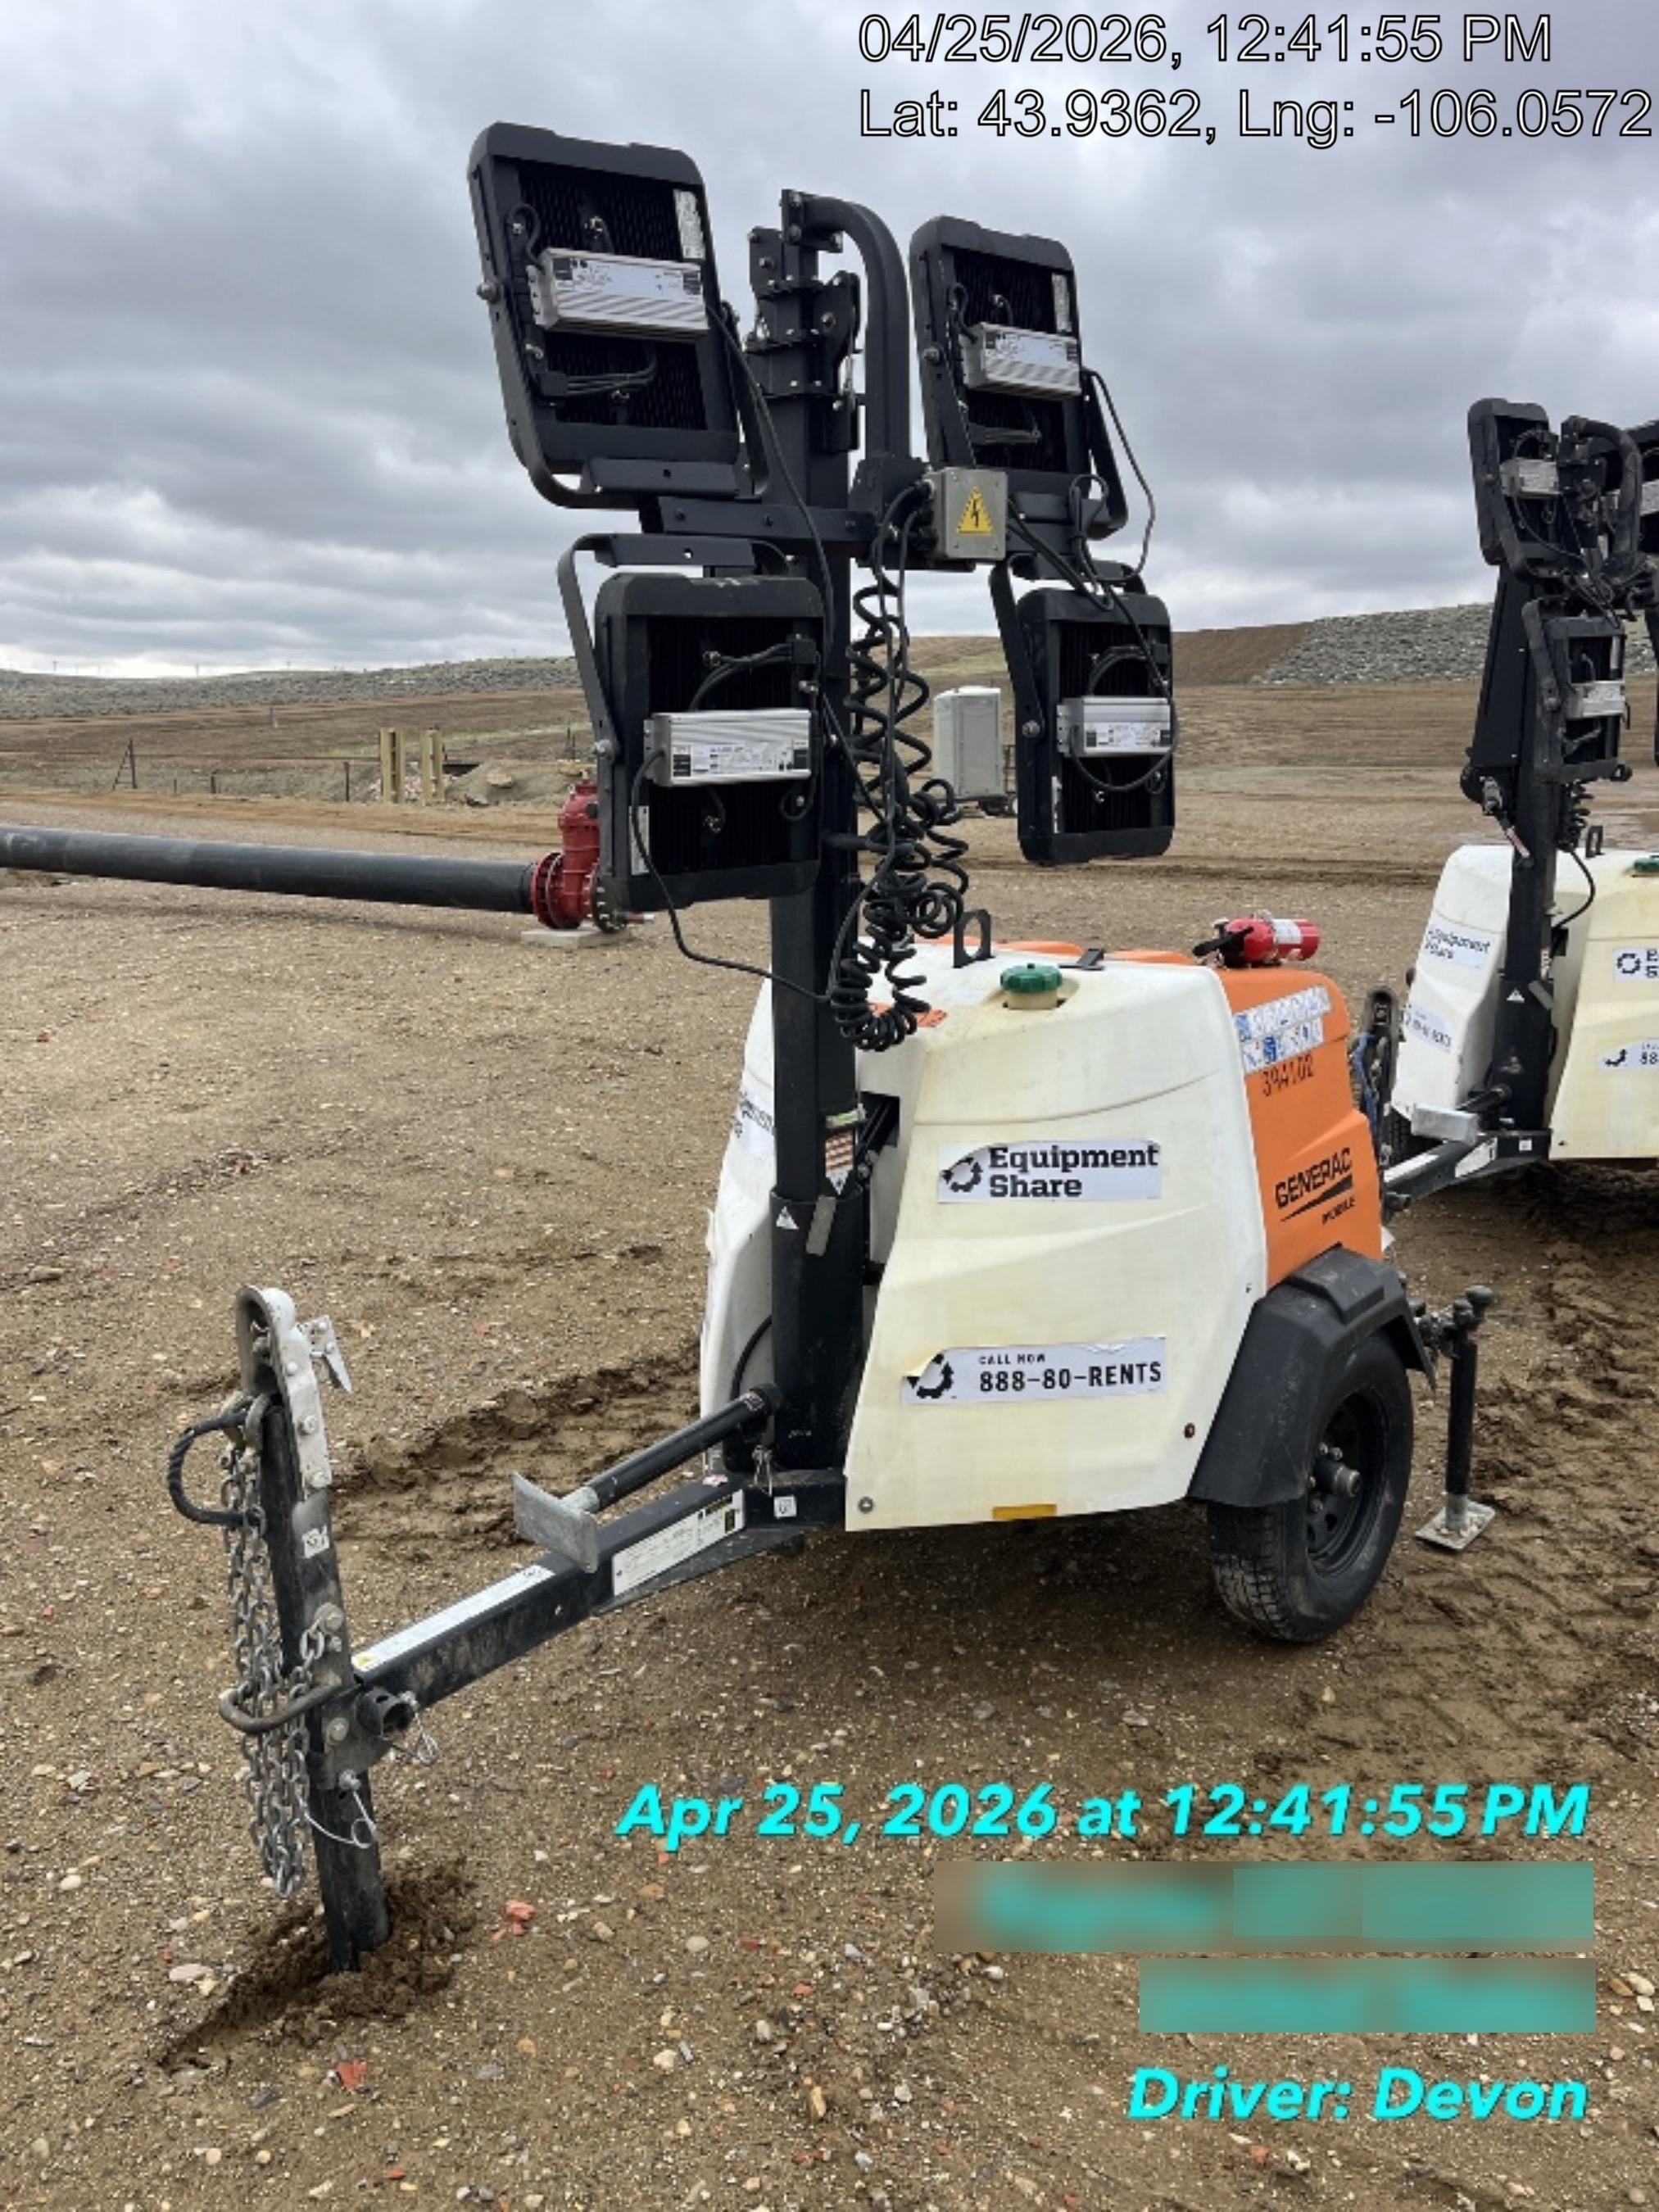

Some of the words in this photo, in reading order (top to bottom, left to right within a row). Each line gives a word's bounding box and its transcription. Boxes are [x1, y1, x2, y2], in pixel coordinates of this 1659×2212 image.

[988, 1145, 1159, 1173] Equipment
[989, 1174, 1082, 1198] Share
[1275, 1147, 1353, 1209] GENERAC
[978, 1353, 1012, 1366] CALL
[979, 1362, 1162, 1393] 888-80-RENTS
